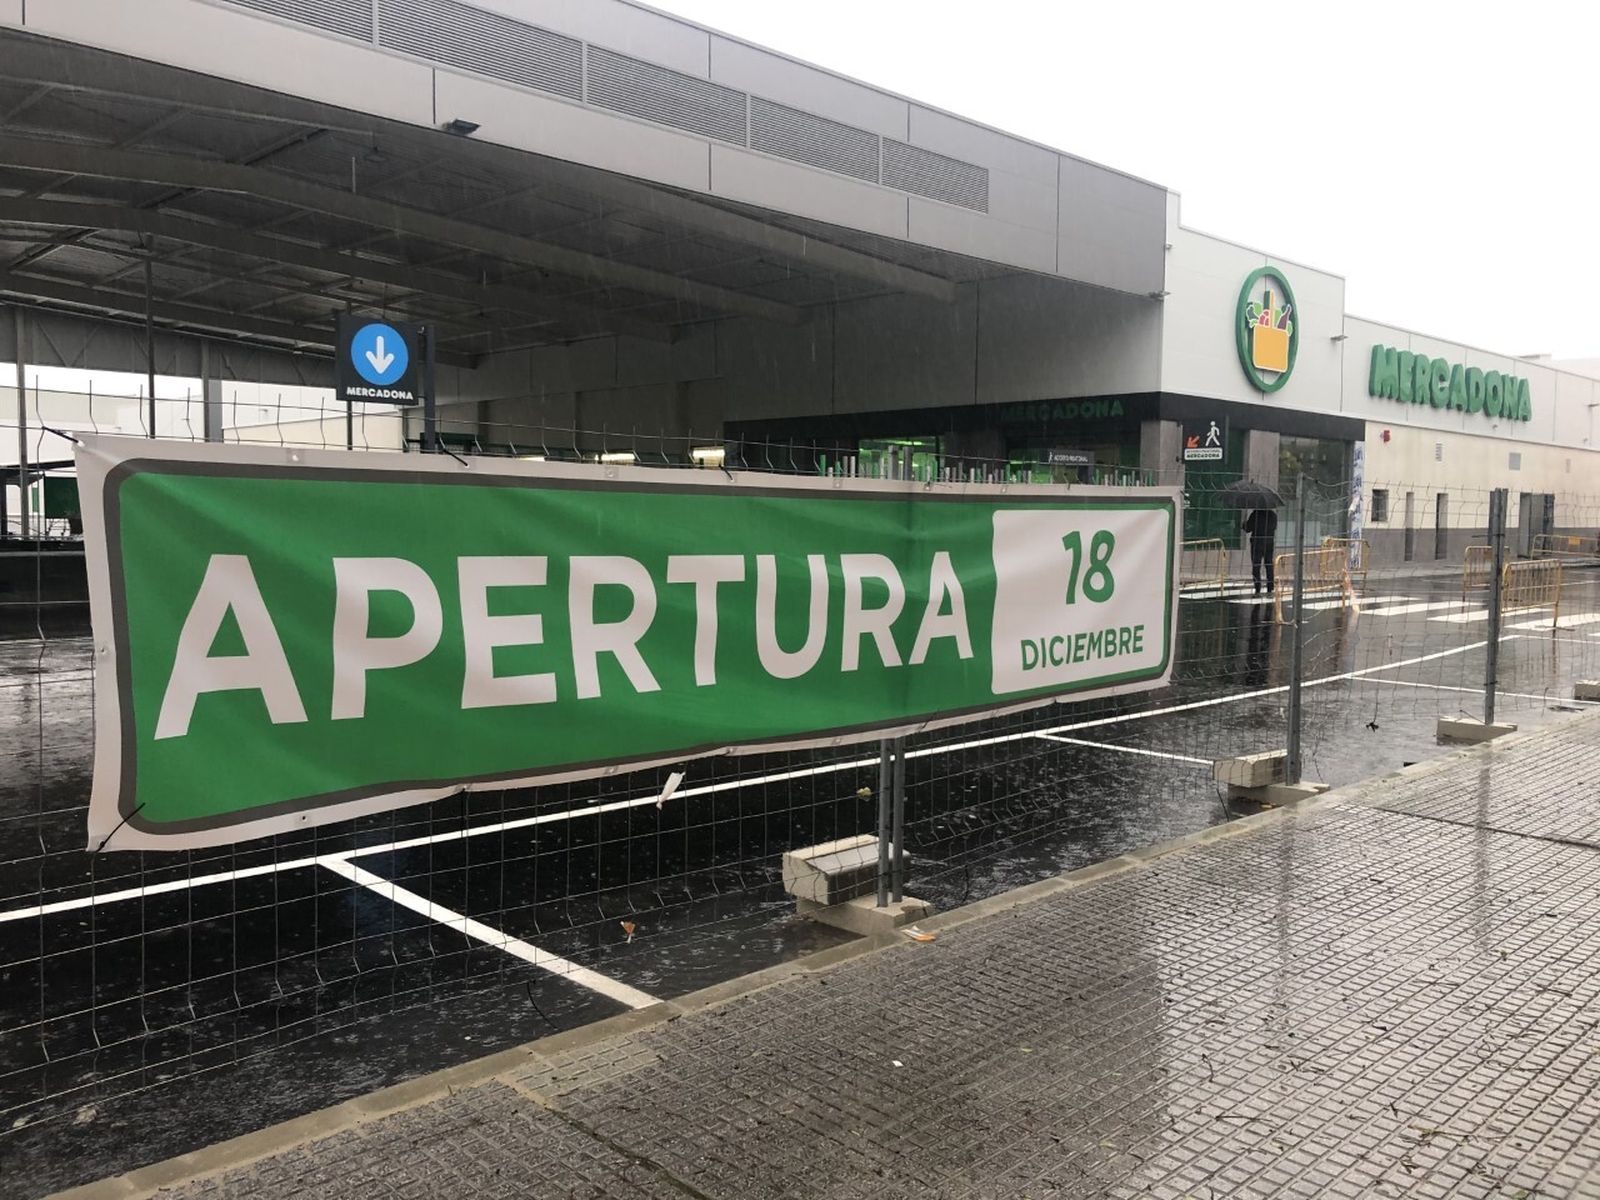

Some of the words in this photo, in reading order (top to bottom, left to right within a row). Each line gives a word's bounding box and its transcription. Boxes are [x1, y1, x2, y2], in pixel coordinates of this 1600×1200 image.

[346, 386, 414, 401] MERCADONA
[1369, 344, 1532, 422] MERCADONA
[1062, 529, 1115, 604] 18
[154, 552, 974, 741] APERTURA
[1021, 625, 1145, 671] DICIEMBRE
